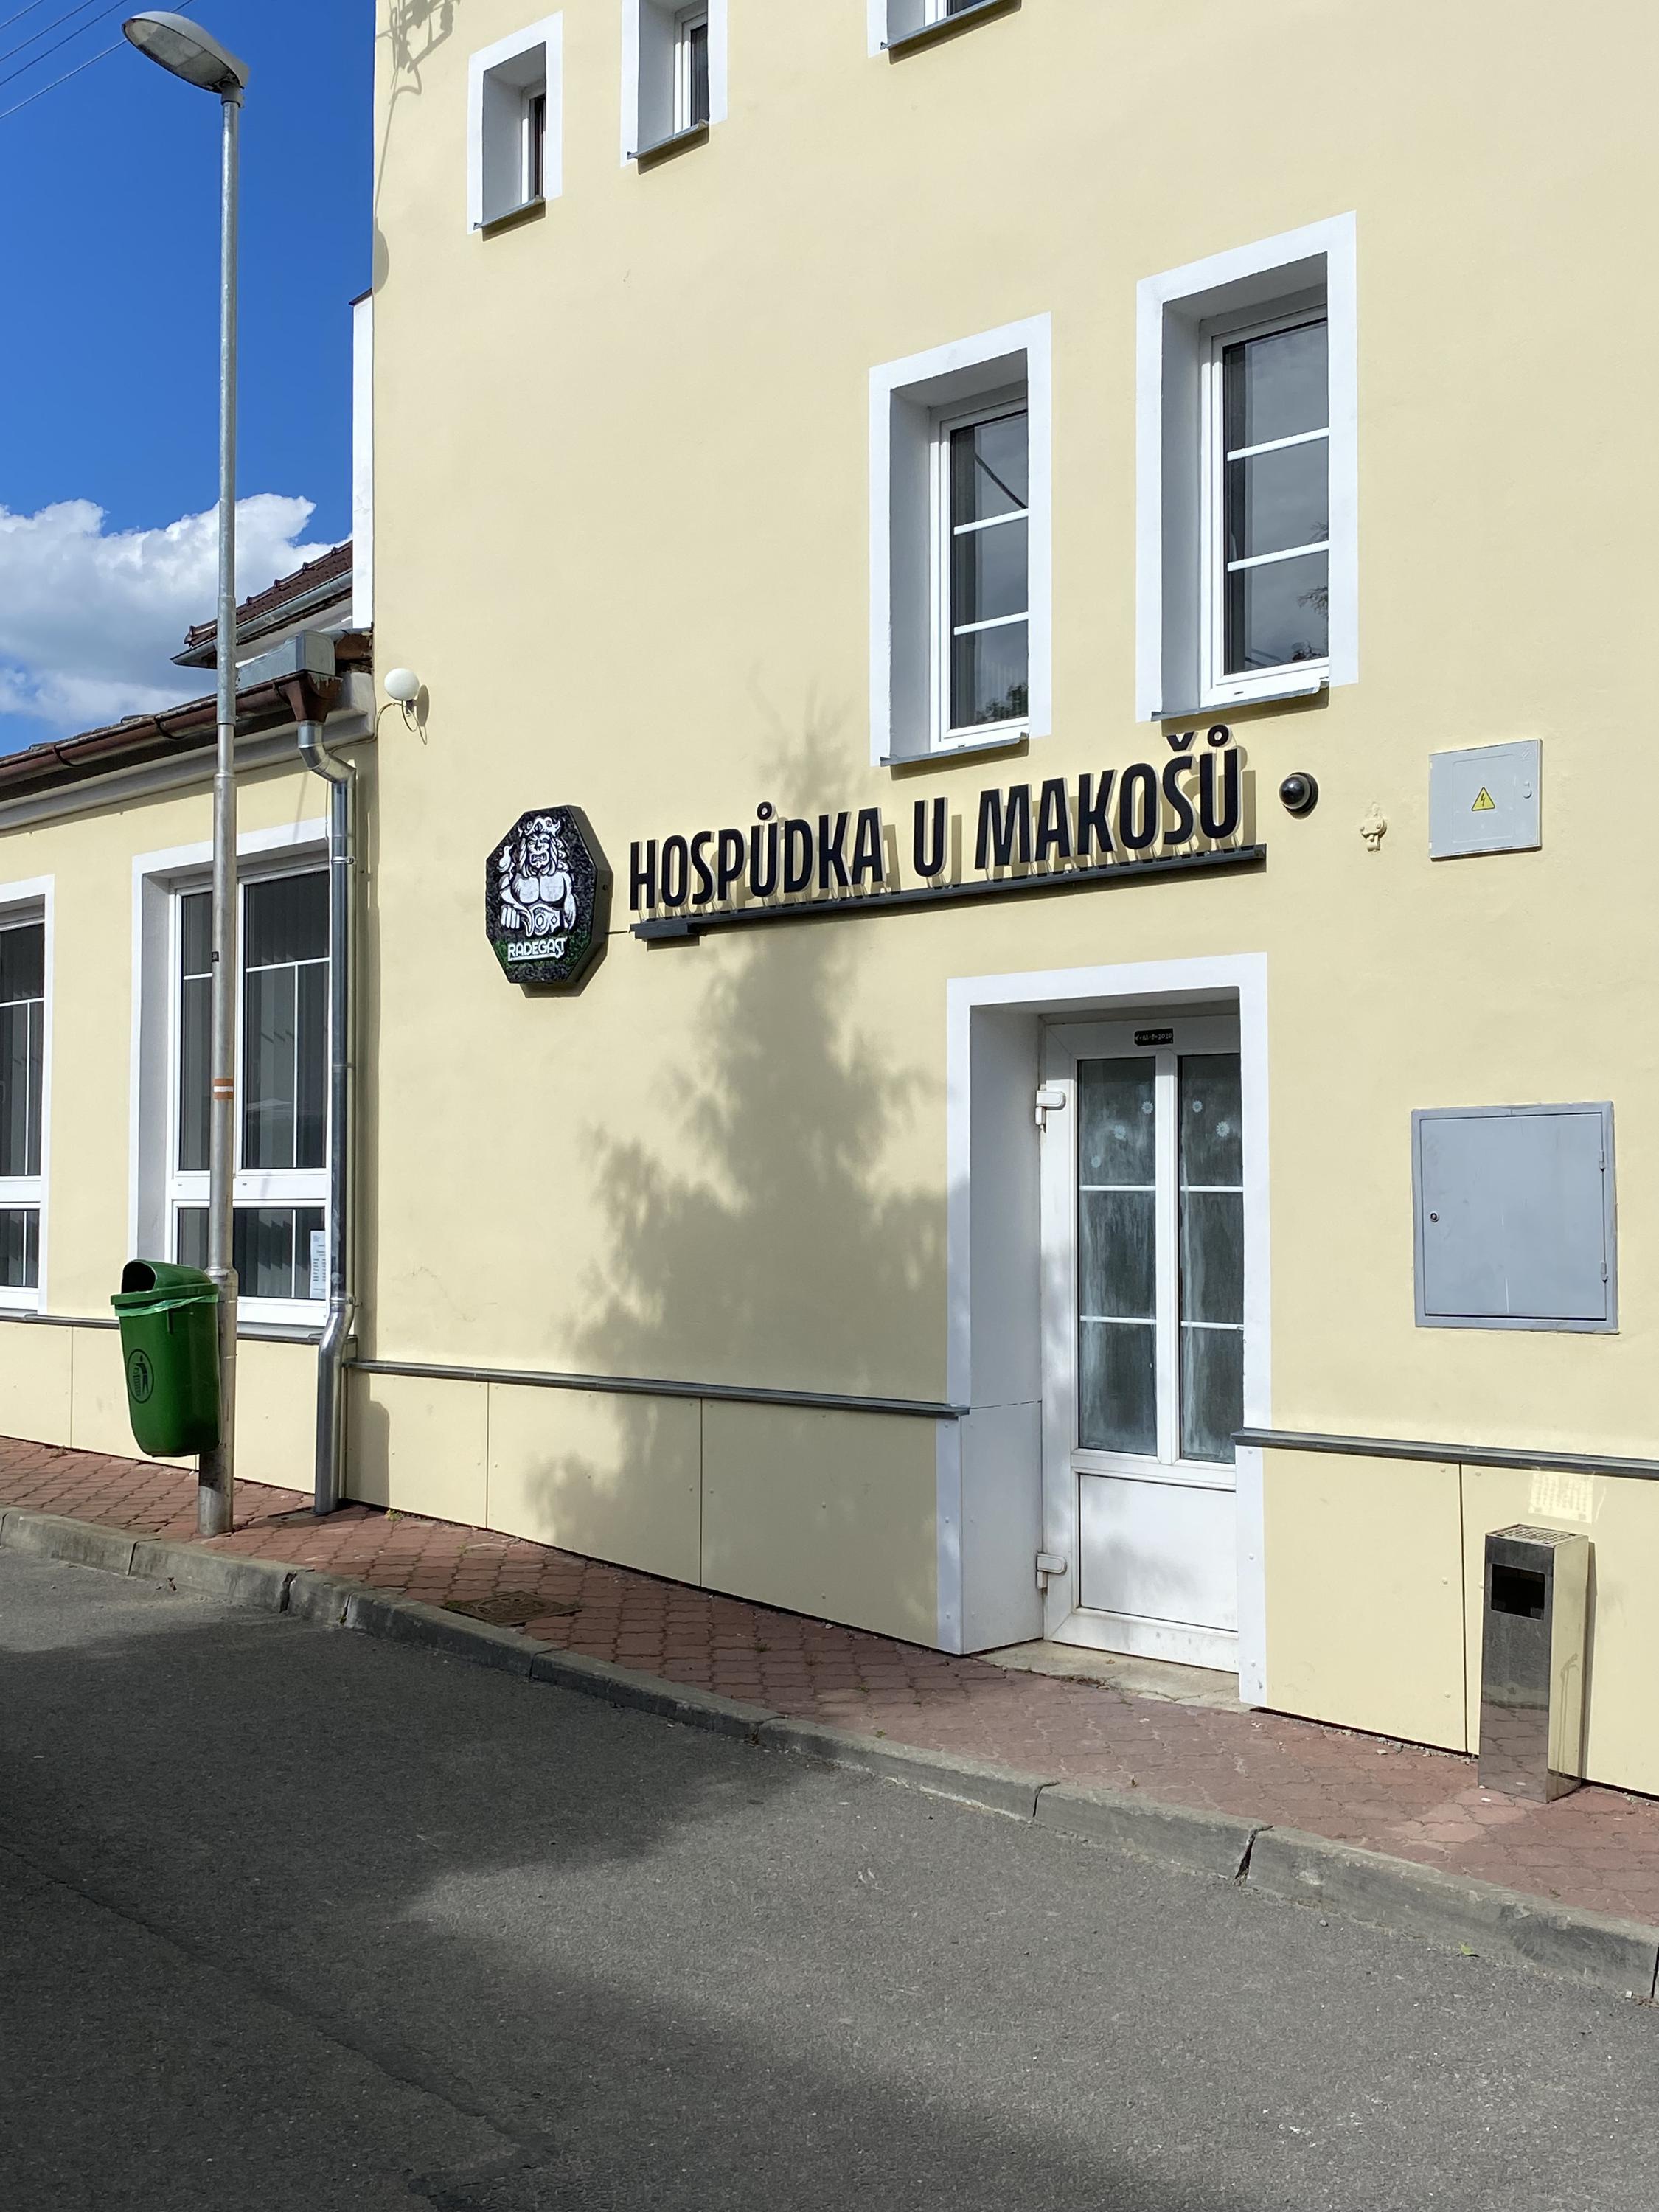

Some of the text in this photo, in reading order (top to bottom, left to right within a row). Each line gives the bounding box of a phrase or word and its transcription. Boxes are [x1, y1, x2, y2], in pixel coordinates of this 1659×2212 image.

[630, 724, 1240, 911] HOSPŮDKA U MAKOŠŮ
[507, 936, 567, 961] RADEGAST
